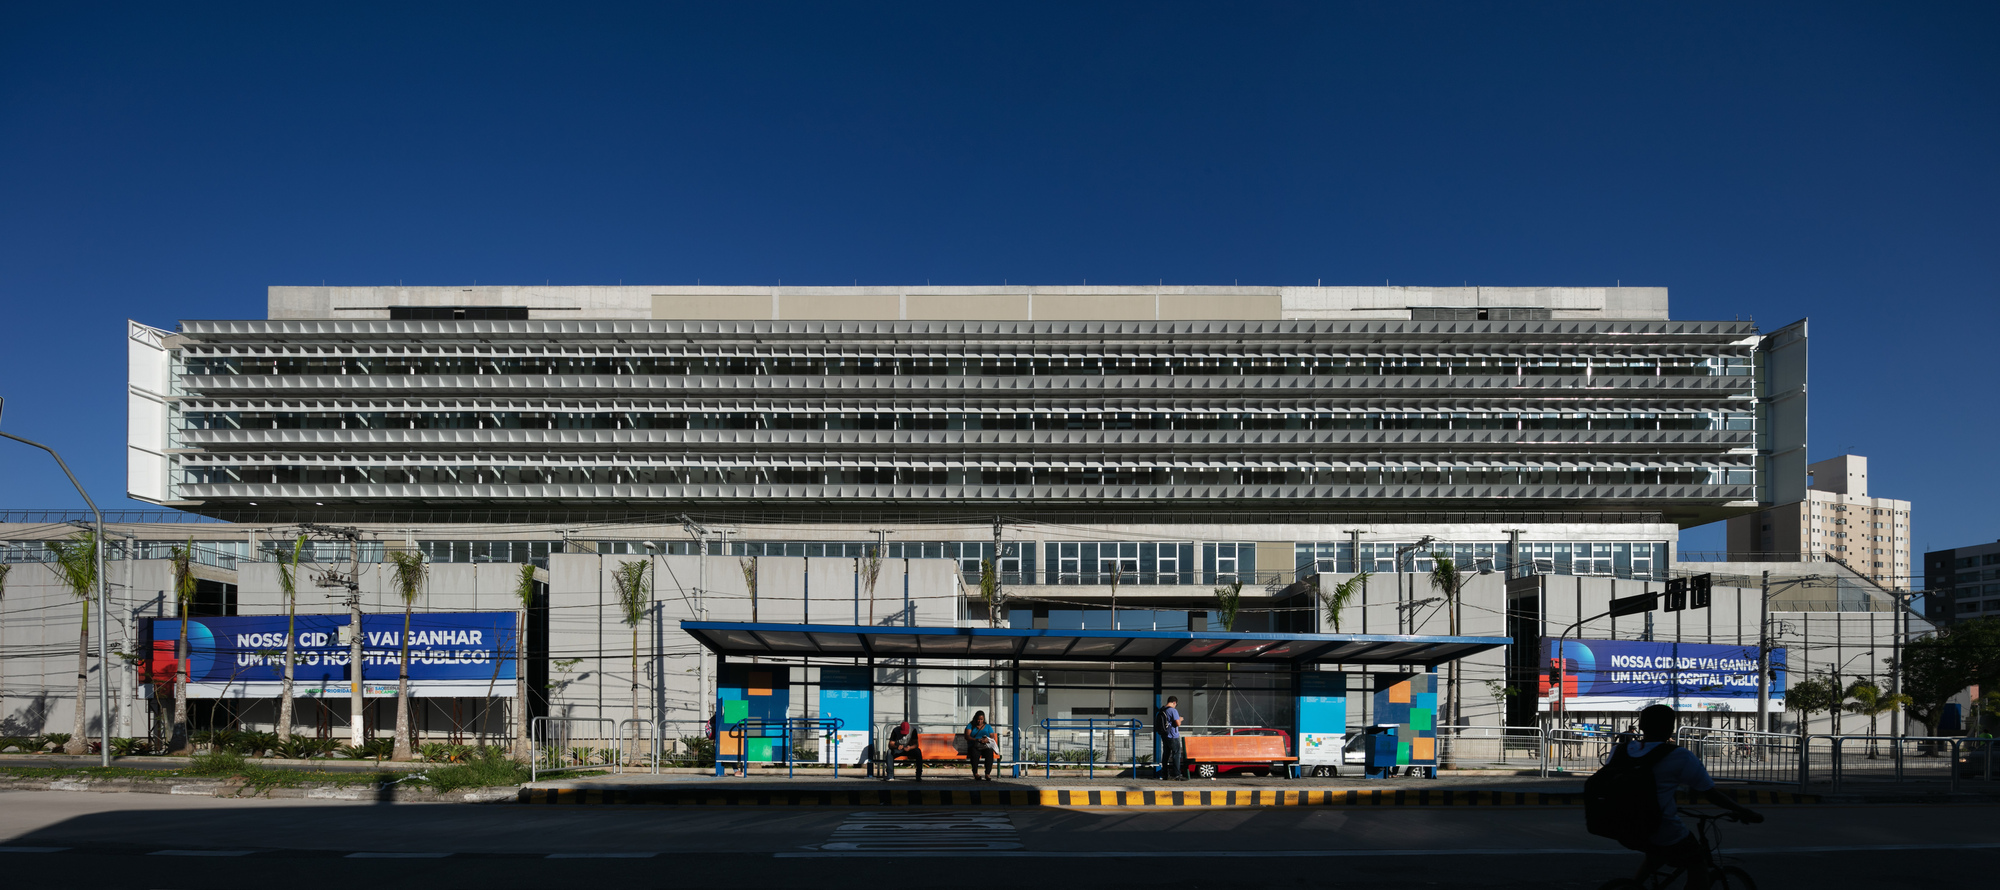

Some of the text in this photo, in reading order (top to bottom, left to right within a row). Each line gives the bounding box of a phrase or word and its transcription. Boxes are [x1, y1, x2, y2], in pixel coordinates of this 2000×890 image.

[237, 630, 483, 648] NOSSA CIDA VAI GANHAR
[237, 651, 264, 667] UM
[410, 646, 490, 665] PÚBLICO!
[1611, 654, 1760, 672] NOSSA CIDADE VAI GANHA
[1611, 671, 1630, 684] UM
[1632, 671, 1669, 685] NOVO
[1724, 671, 1770, 687] PÚBLIC
